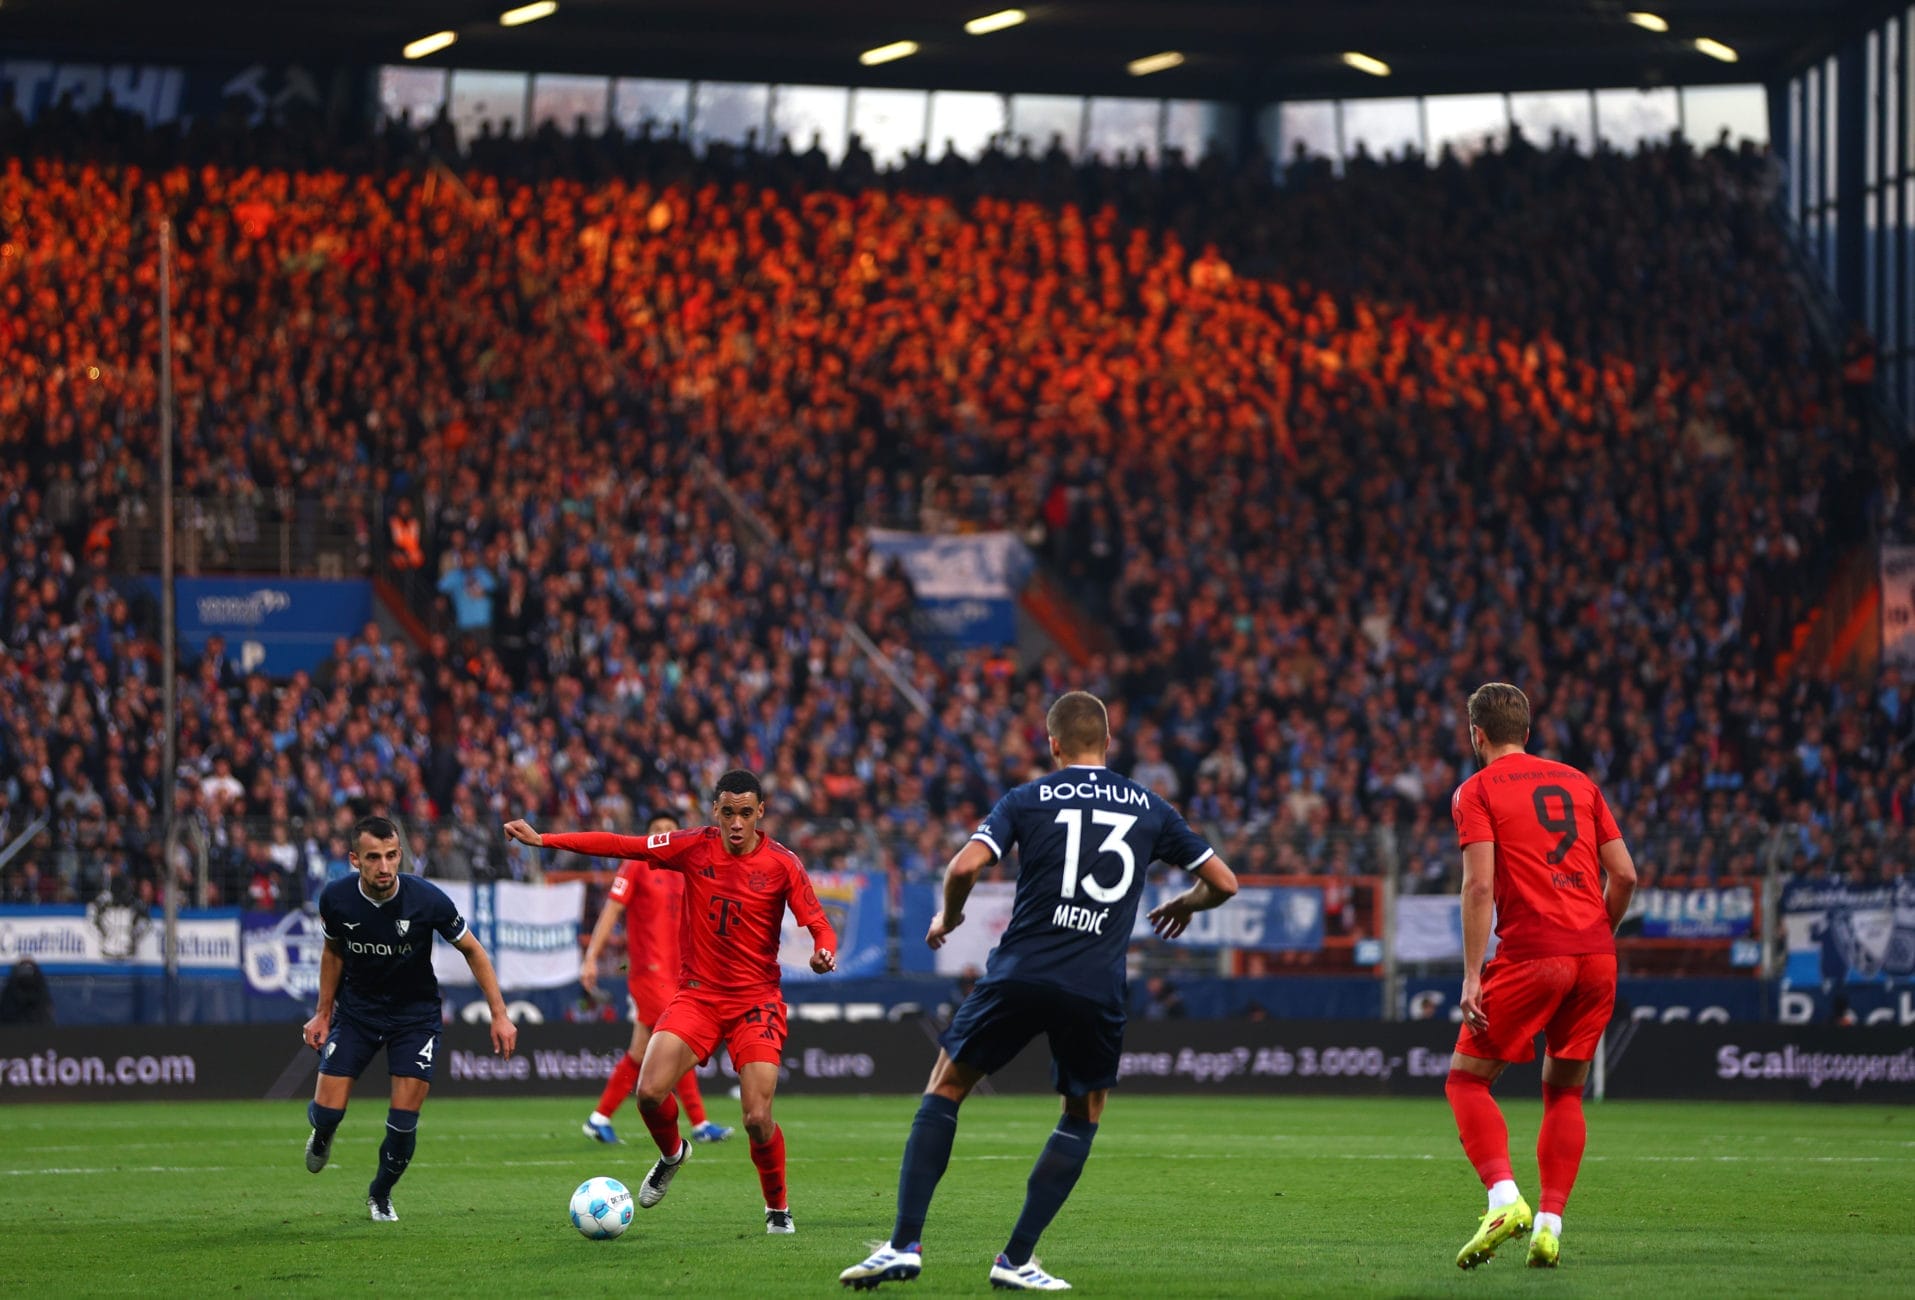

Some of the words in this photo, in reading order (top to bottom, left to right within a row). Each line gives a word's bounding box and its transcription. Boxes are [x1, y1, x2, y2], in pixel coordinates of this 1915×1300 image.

[1039, 783, 1150, 809] BOCHUM
[1533, 785, 1578, 864] 9
[1054, 808, 1138, 903] 13
[1551, 871, 1587, 889] KANE
[1052, 904, 1109, 935] MEDIĆ
[744, 1002, 779, 1029] 42
[418, 1034, 436, 1062] 4
[1253, 1047, 1295, 1076] Ab
[450, 1050, 531, 1080] Neue
[803, 1048, 875, 1078] Euro
